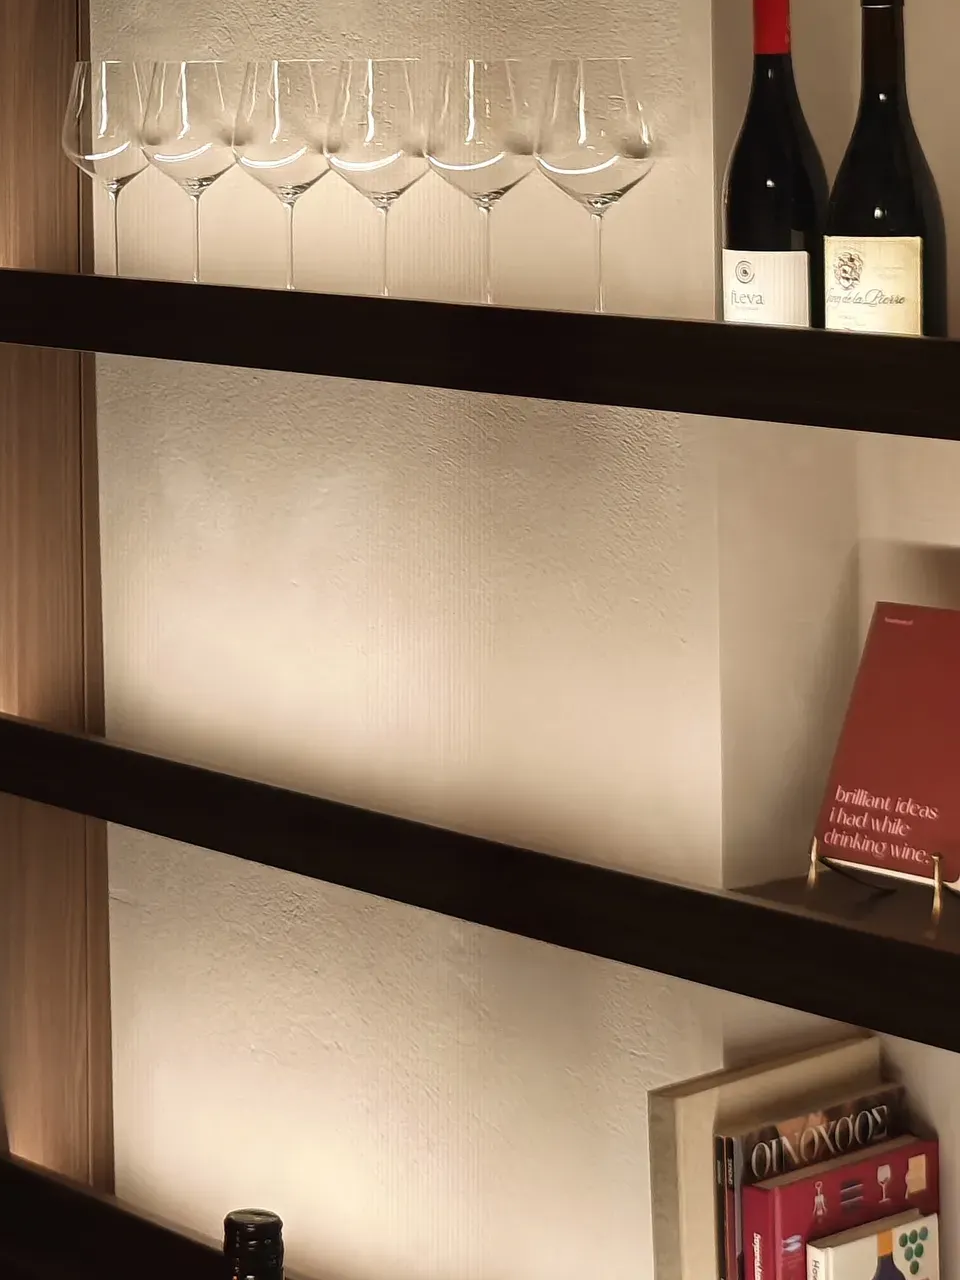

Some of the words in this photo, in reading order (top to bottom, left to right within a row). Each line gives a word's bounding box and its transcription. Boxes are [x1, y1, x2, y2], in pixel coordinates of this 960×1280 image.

[835, 785, 891, 811] brilliant
[895, 797, 939, 820] ideas
[829, 807, 835, 822] i
[836, 807, 868, 828] had
[871, 815, 912, 836] while
[824, 828, 887, 858] drinking
[890, 842, 930, 865] wine.
